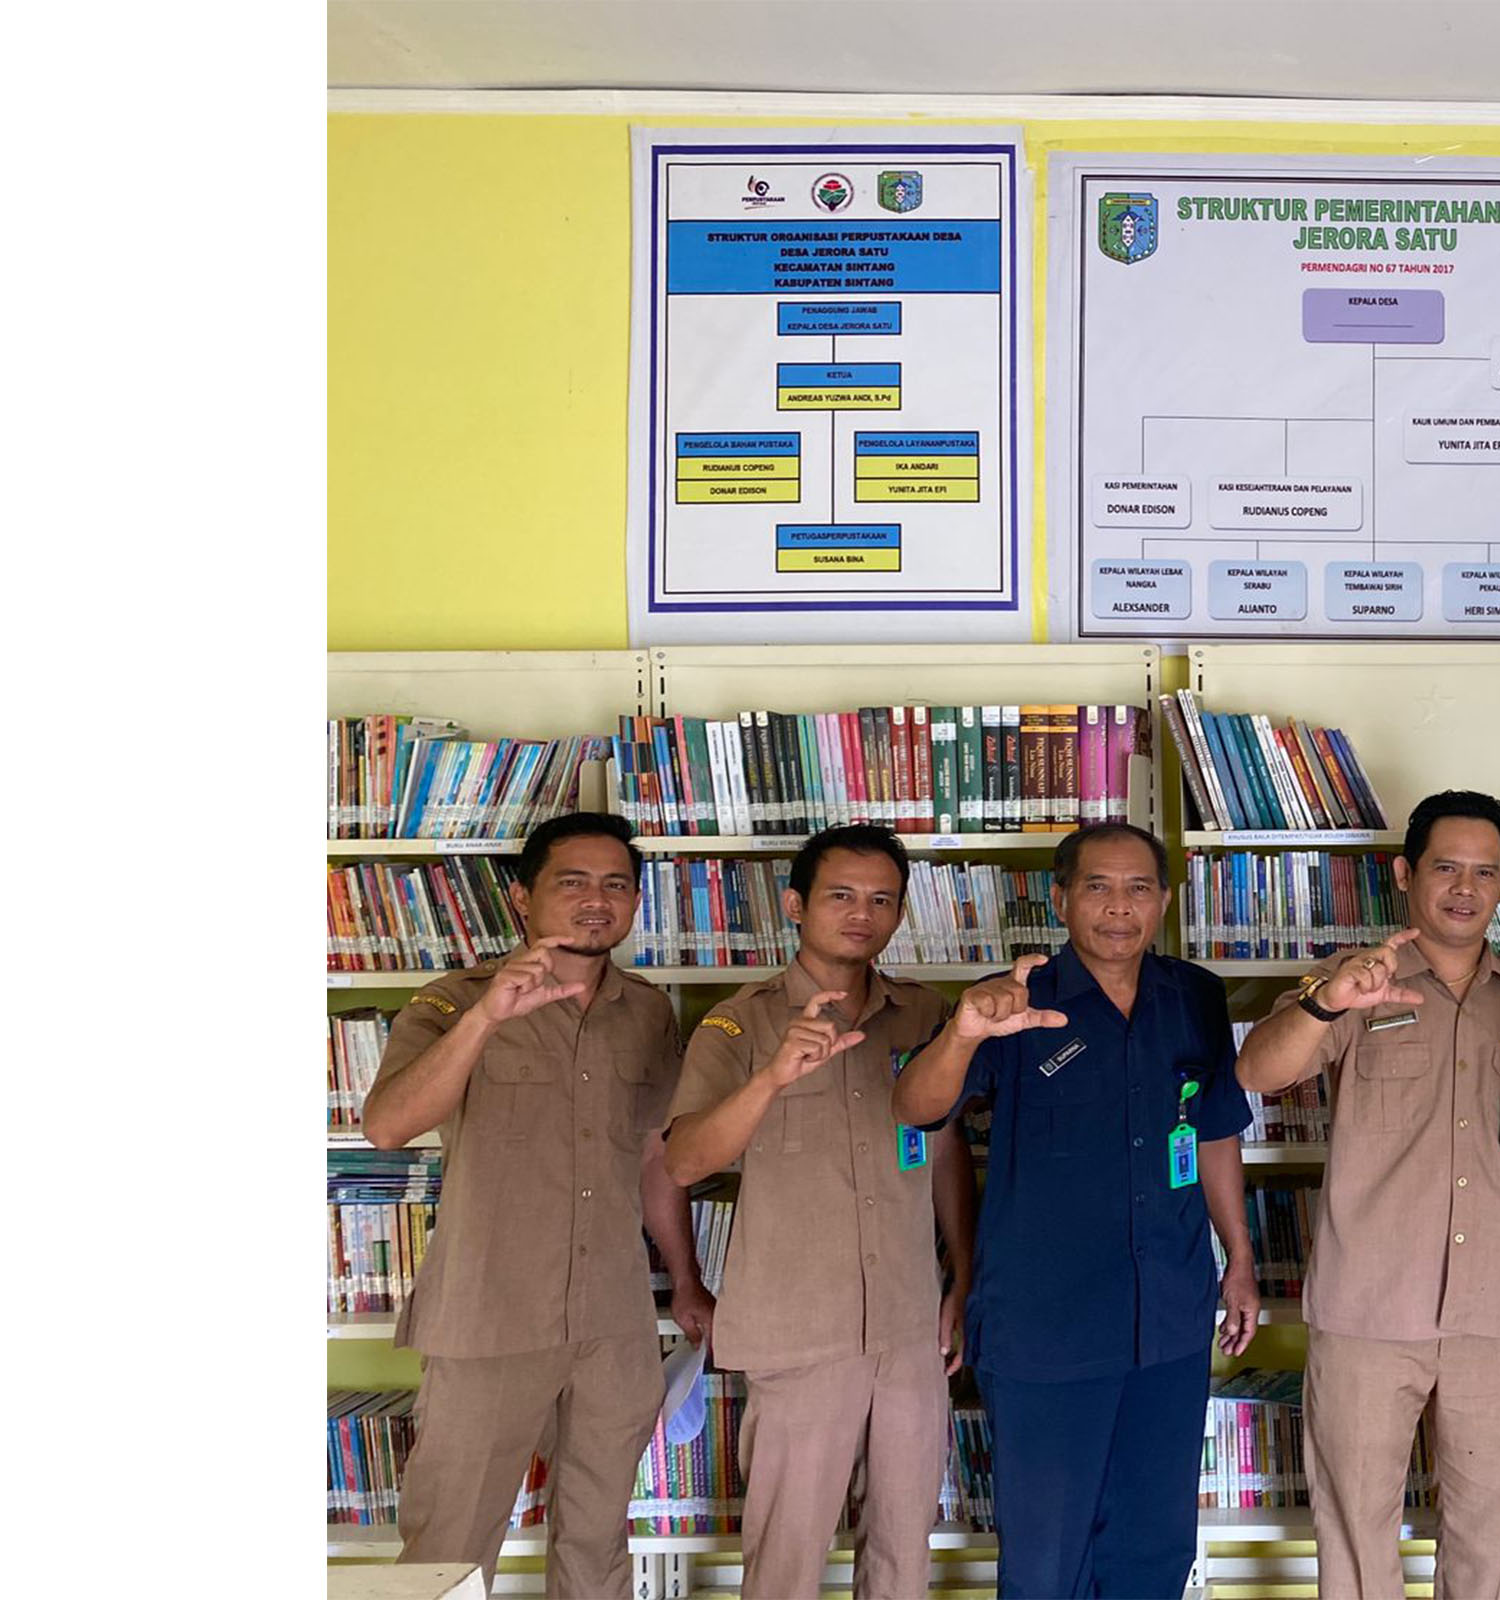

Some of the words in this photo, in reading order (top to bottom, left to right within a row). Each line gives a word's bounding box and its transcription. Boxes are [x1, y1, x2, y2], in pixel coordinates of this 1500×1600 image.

[1177, 197, 1308, 221] STRUKTUR
[707, 233, 768, 242] STRUKTUR
[770, 232, 838, 242] ORGANISASI
[841, 232, 930, 241] PERPUSTAKAAN
[932, 232, 962, 241] DESA
[1293, 226, 1389, 250] JERORA
[1395, 227, 1457, 251] SATU
[780, 247, 809, 257] DESA
[811, 247, 856, 257] JERORA
[858, 247, 889, 256] SATU
[773, 263, 843, 272] KECAMATAN
[845, 262, 895, 271] SINTANG
[1300, 262, 1368, 272] PERMENDAGRI
[1369, 263, 1384, 273] NO
[1385, 263, 1397, 273] 67
[1399, 264, 1431, 273] TAHUN
[1432, 264, 1454, 274] 2017
[774, 278, 842, 287] KABUPATEN
[844, 278, 894, 287] SINTANG
[1348, 297, 1377, 305] KEPALA
[1378, 297, 1398, 306] DESA
[851, 306, 878, 314] JAWAB
[817, 322, 839, 330] DESA
[840, 322, 871, 330] JERORA
[872, 322, 893, 330] SATU
[826, 371, 853, 379] KETUA
[787, 394, 823, 402] ANDREAS
[824, 394, 851, 402] YUZWA
[1412, 418, 1431, 426] KAUR
[1432, 418, 1458, 426] UMUM
[1458, 418, 1474, 426] DAN
[683, 441, 729, 449] PENGELOLA
[758, 440, 794, 448] PUSTAKA
[1438, 440, 1471, 450] YUNITA
[1473, 440, 1491, 450] JITA
[702, 464, 741, 472] RUDIANUS
[934, 485, 947, 493] EFI
[1121, 482, 1178, 490] PEMERINTAHAN
[1218, 483, 1234, 491] KASI
[1235, 483, 1292, 492] KESEJAHTERAAN
[1293, 484, 1309, 492] DAN
[1310, 485, 1352, 493] PELAYANAN
[709, 487, 737, 495] DONAR
[1107, 504, 1140, 514] DONAR
[1141, 504, 1175, 514] EDISON
[1242, 506, 1290, 516] RUDIANUS
[1291, 507, 1328, 517] COPENG
[813, 555, 845, 563] SUSANA
[846, 555, 864, 563] BINA
[1099, 567, 1126, 575] KEPALA
[1127, 567, 1160, 575] WILAYAH
[1161, 568, 1183, 576] LEBAK
[1227, 568, 1254, 577] KEPALA
[1254, 569, 1288, 577] WILAYAH
[1344, 570, 1370, 578] KEPALA
[1371, 570, 1404, 578] WILAYAH
[1461, 571, 1487, 579] KEPALA
[1125, 580, 1157, 588] NANGKA
[1243, 582, 1272, 590] SERABU
[1384, 583, 1403, 591] SIRIH
[1112, 602, 1170, 612] ALEXSANDER
[1238, 604, 1277, 614] ALIANTO
[1352, 605, 1395, 615] SUPARNO
[1464, 606, 1485, 615] HERI
